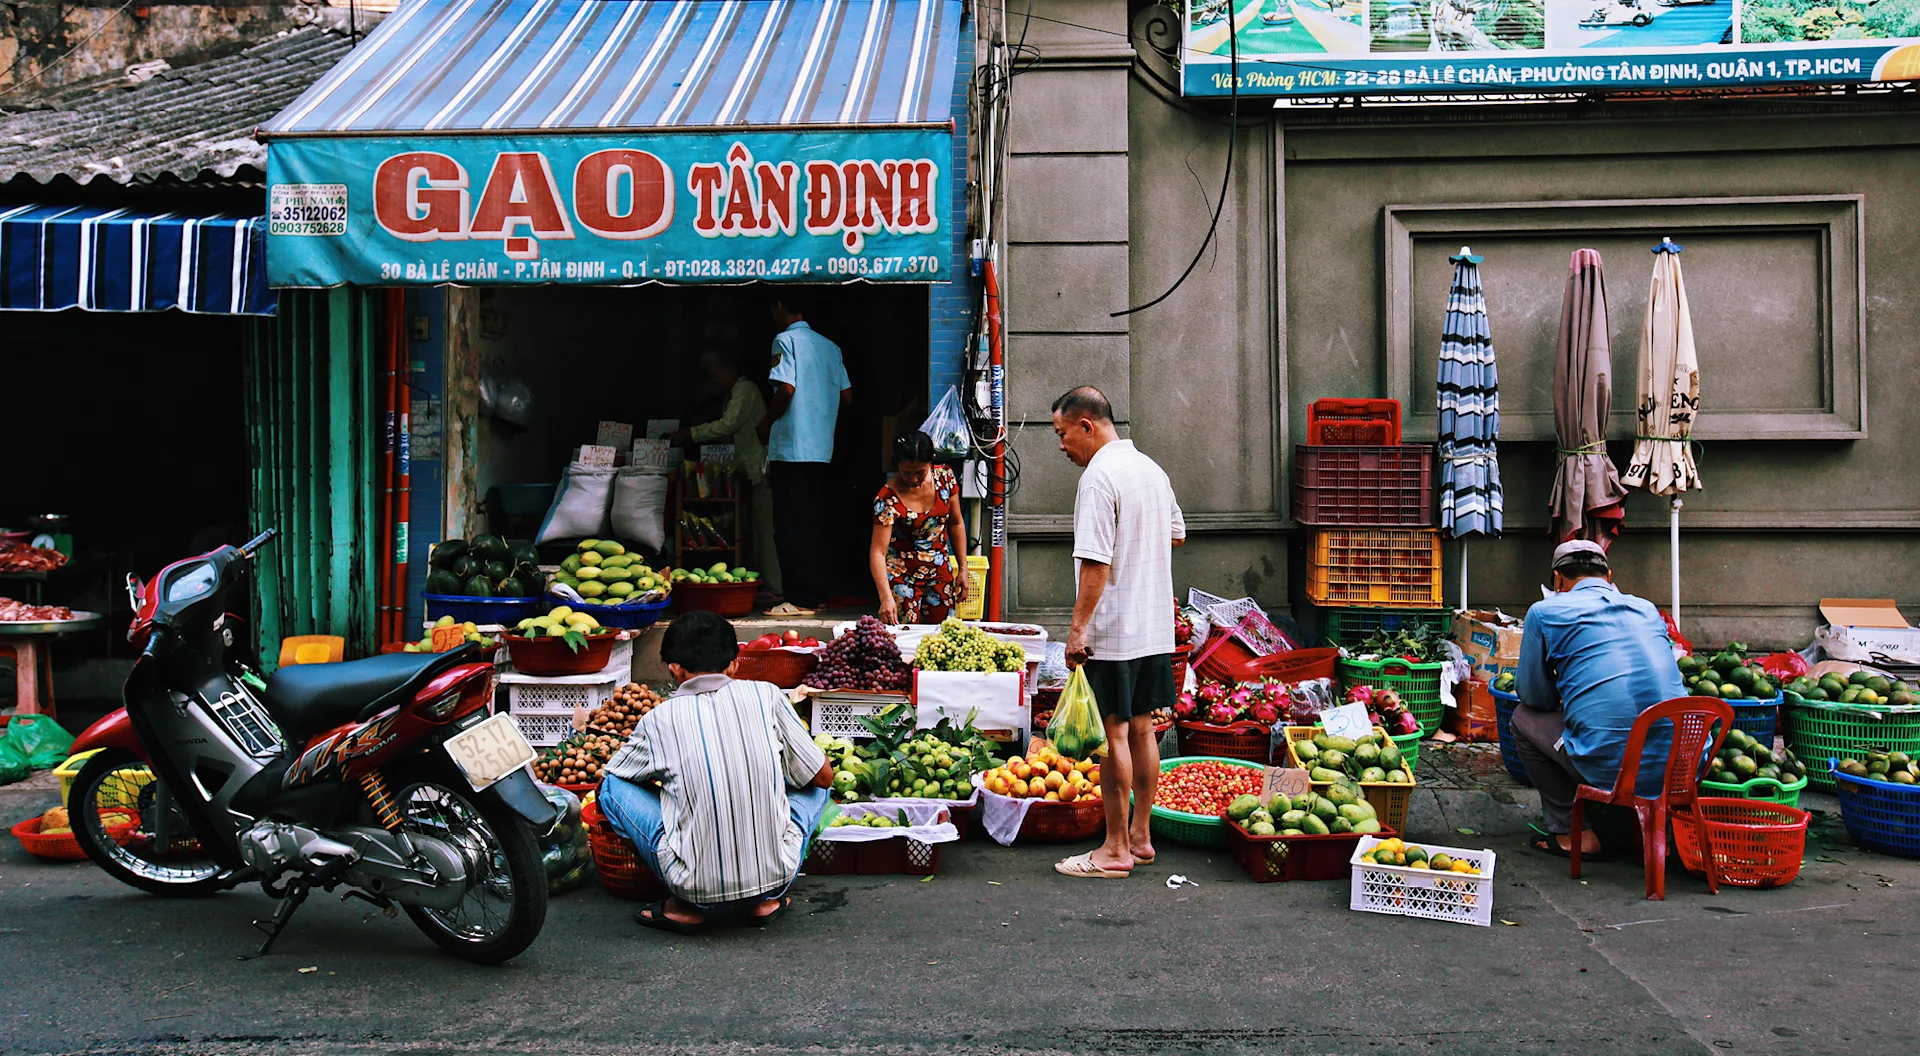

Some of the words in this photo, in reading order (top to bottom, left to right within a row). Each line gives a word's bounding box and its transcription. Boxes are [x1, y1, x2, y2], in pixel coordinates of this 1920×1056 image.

[1246, 71, 1295, 91] Phòng
[1298, 70, 1341, 86] HCM:
[1345, 70, 1401, 85] 22-28
[1433, 65, 1455, 84] LÊ
[1458, 64, 1517, 84] CHÂN,
[1521, 62, 1604, 83] PHƯỜNG
[1607, 61, 1645, 81] TÂN
[1649, 63, 1703, 84] ĐỊNH,
[1707, 58, 1764, 82] QUẬN
[1785, 58, 1860, 76] TP.HCM
[310, 196, 334, 206] NAM
[374, 148, 676, 260] GẠO
[687, 141, 800, 239] TÂN
[804, 158, 939, 255] ĐỊNH
[283, 206, 346, 221] 35122062
[271, 222, 344, 234] 0903752628
[381, 262, 400, 279] 30
[406, 260, 428, 279] BÀ
[432, 260, 450, 279] LÊ
[455, 260, 498, 279] CHÂN
[515, 259, 561, 278] P.TÂN
[565, 261, 603, 282] ĐỊNH
[622, 260, 647, 278] Q.1
[665, 258, 810, 277] ĐT:028.3820.4274
[827, 256, 938, 275] 0903.677.370
[175, 737, 208, 745] HONDA
